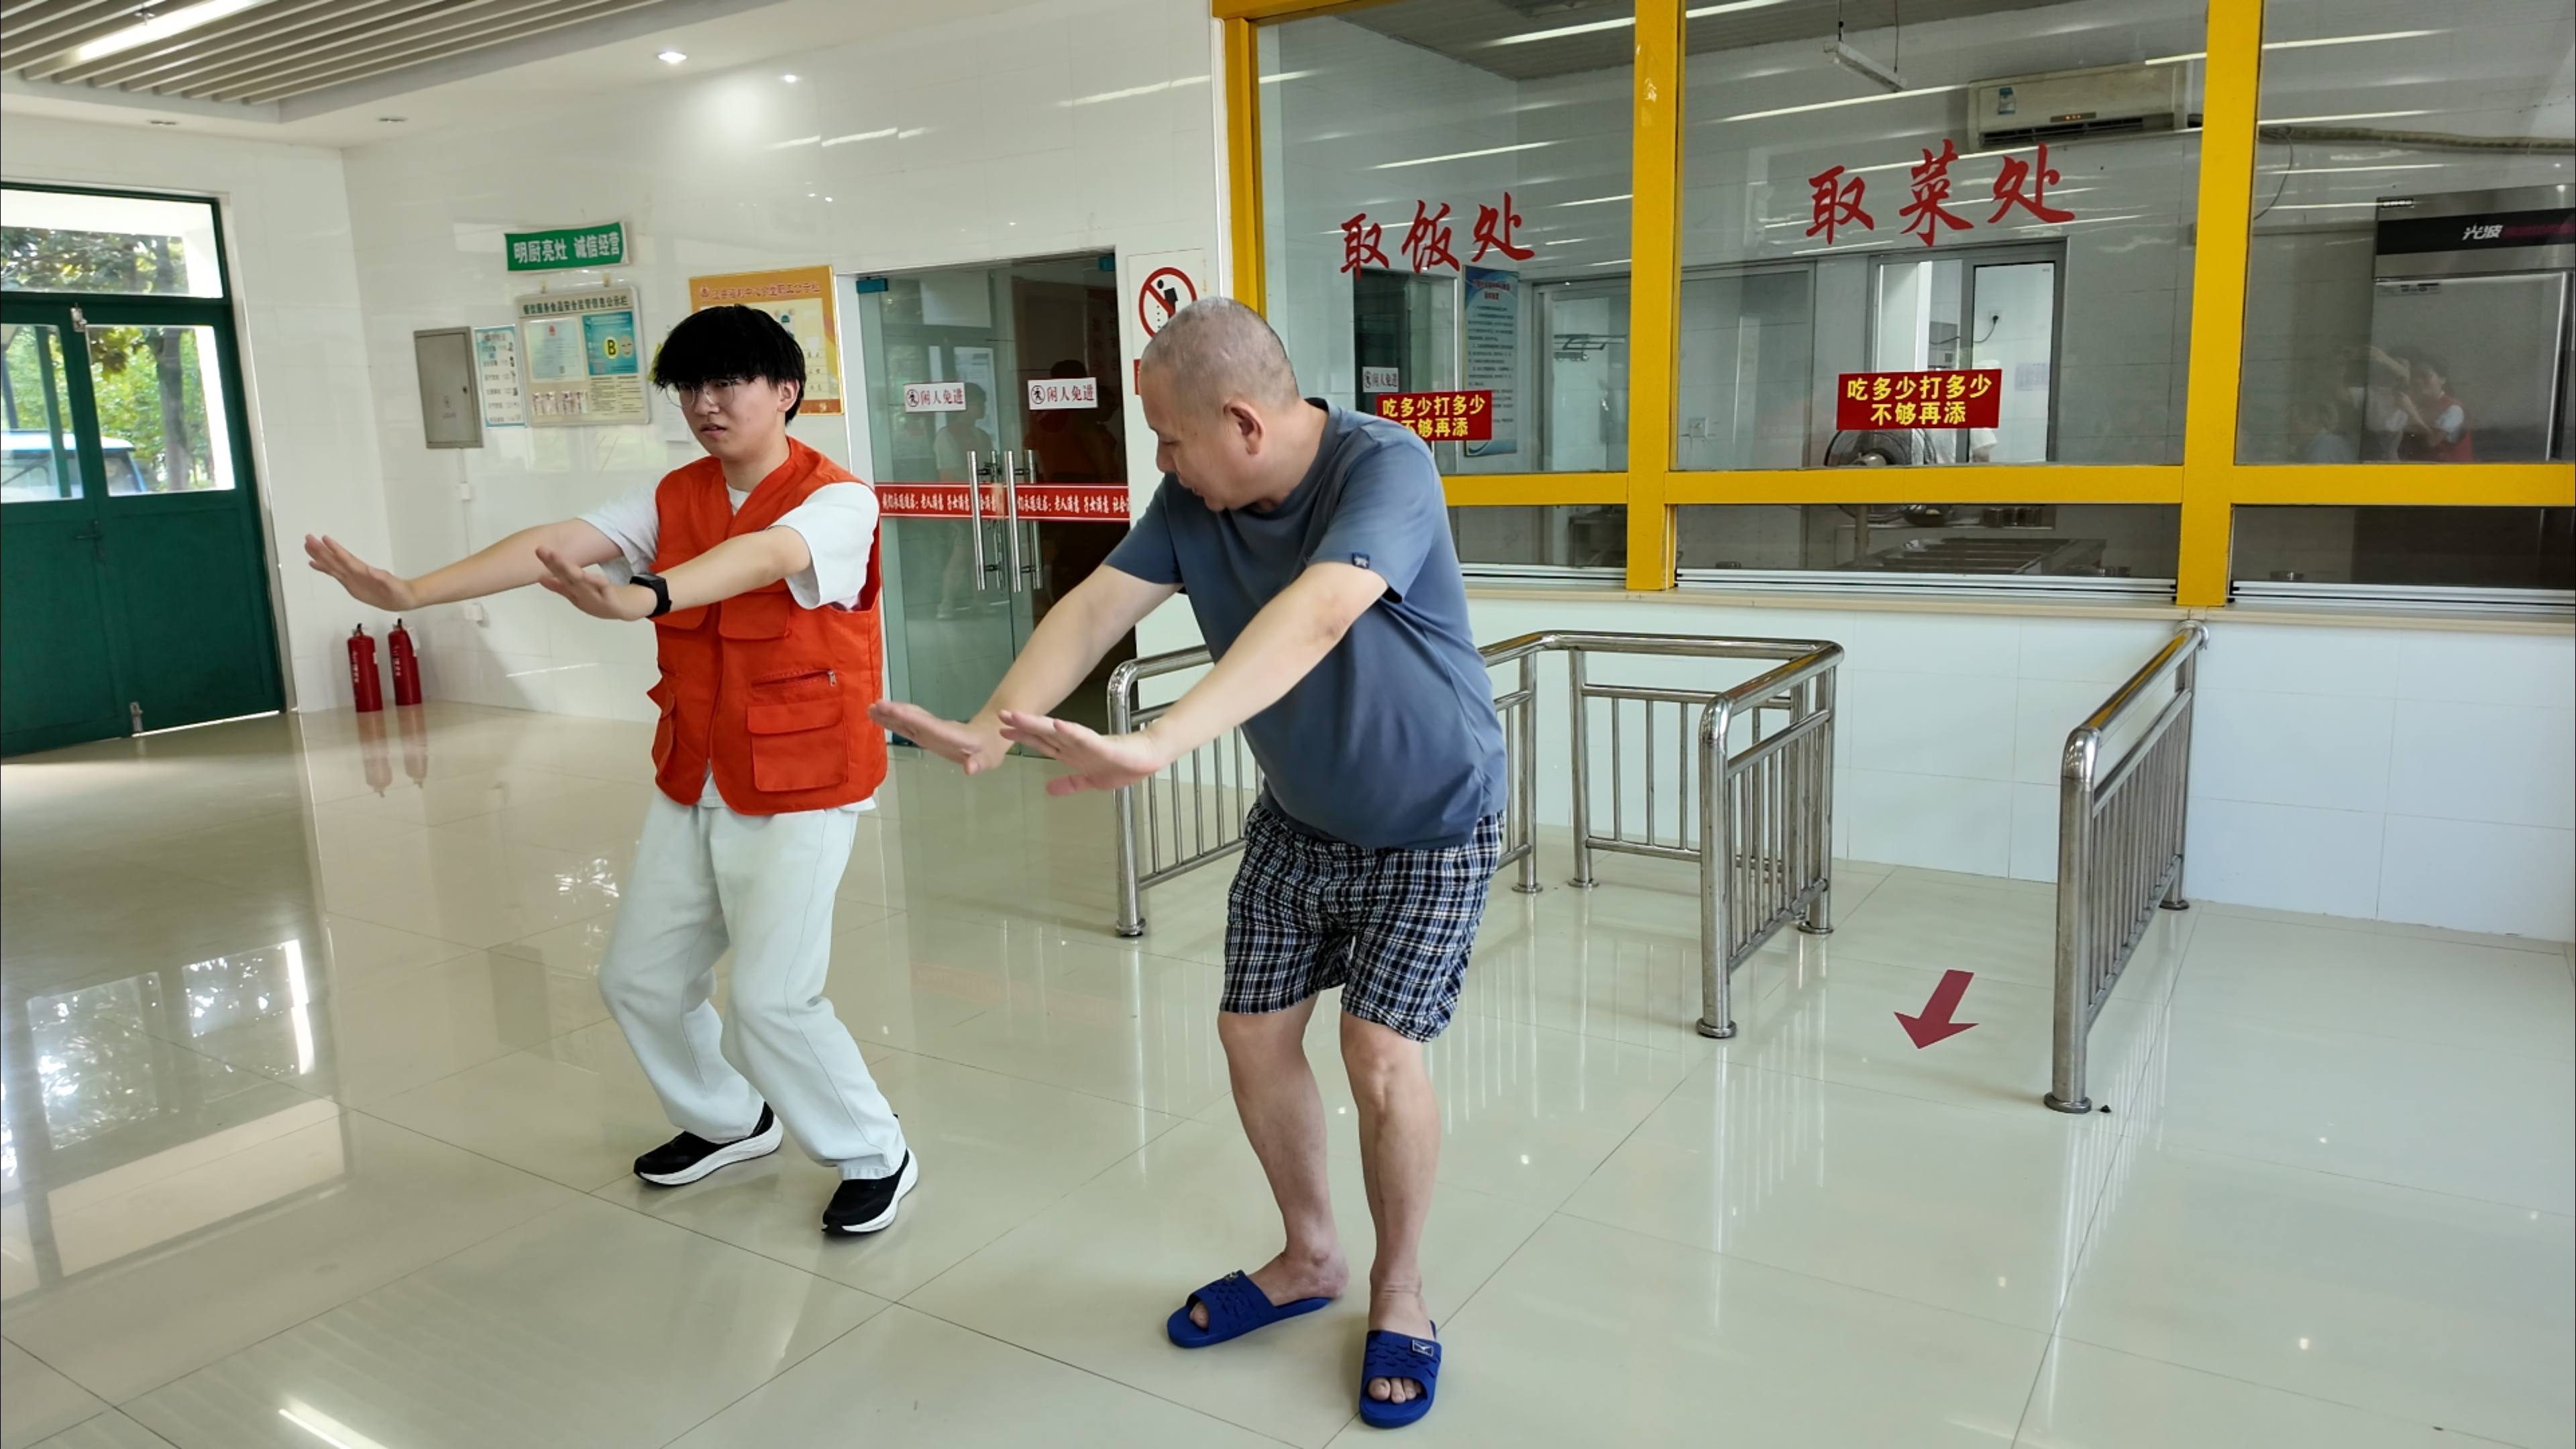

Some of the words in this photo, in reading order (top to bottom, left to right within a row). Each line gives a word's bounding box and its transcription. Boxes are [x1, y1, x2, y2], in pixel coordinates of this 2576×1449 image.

[1806, 139, 2076, 247] 取菜处
[514, 238, 568, 264] 明厨亮灶
[574, 231, 620, 259] 诚信经营
[1340, 192, 1535, 280] 取饭处
[606, 339, 616, 356] B
[920, 388, 964, 406] 闲人免进
[1046, 384, 1094, 402] 闲人免进
[1847, 374, 1992, 401] 吃多少打多少
[1383, 394, 1485, 418] 吃多少打多少
[1870, 401, 1966, 426] 不够再添
[1401, 417, 1468, 437] 不够再添
